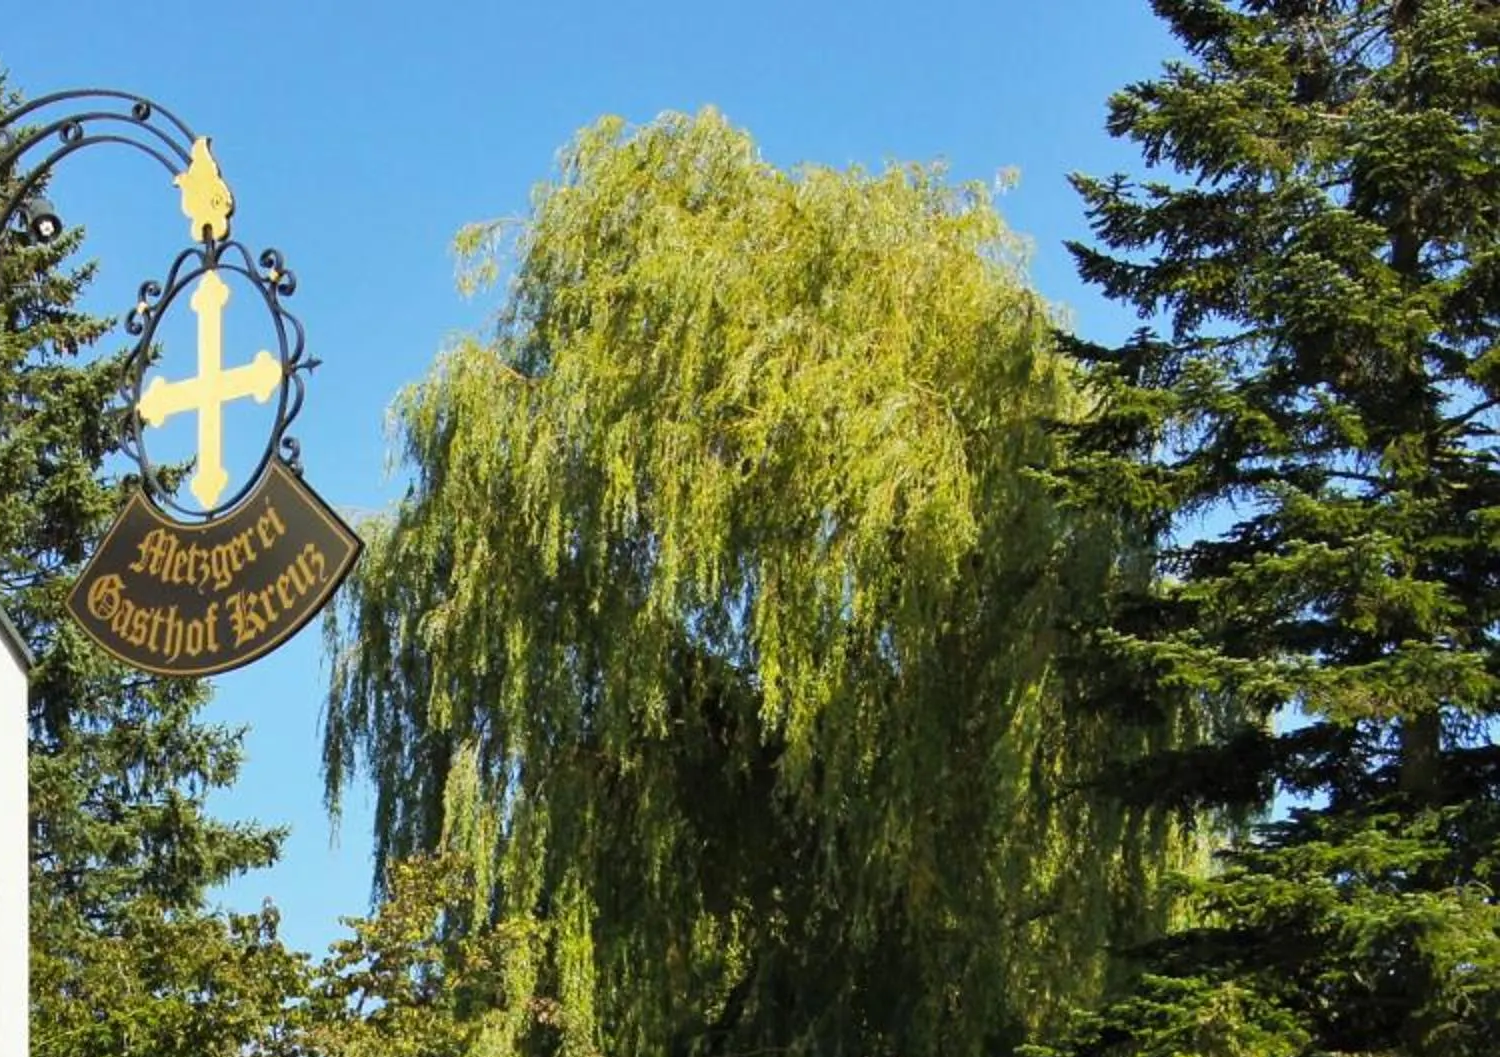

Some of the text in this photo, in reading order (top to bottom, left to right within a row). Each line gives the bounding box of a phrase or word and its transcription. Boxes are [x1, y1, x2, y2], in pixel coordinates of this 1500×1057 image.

[128, 496, 287, 595] Metzgerei
[86, 543, 329, 664] Gasthof Kreuz
